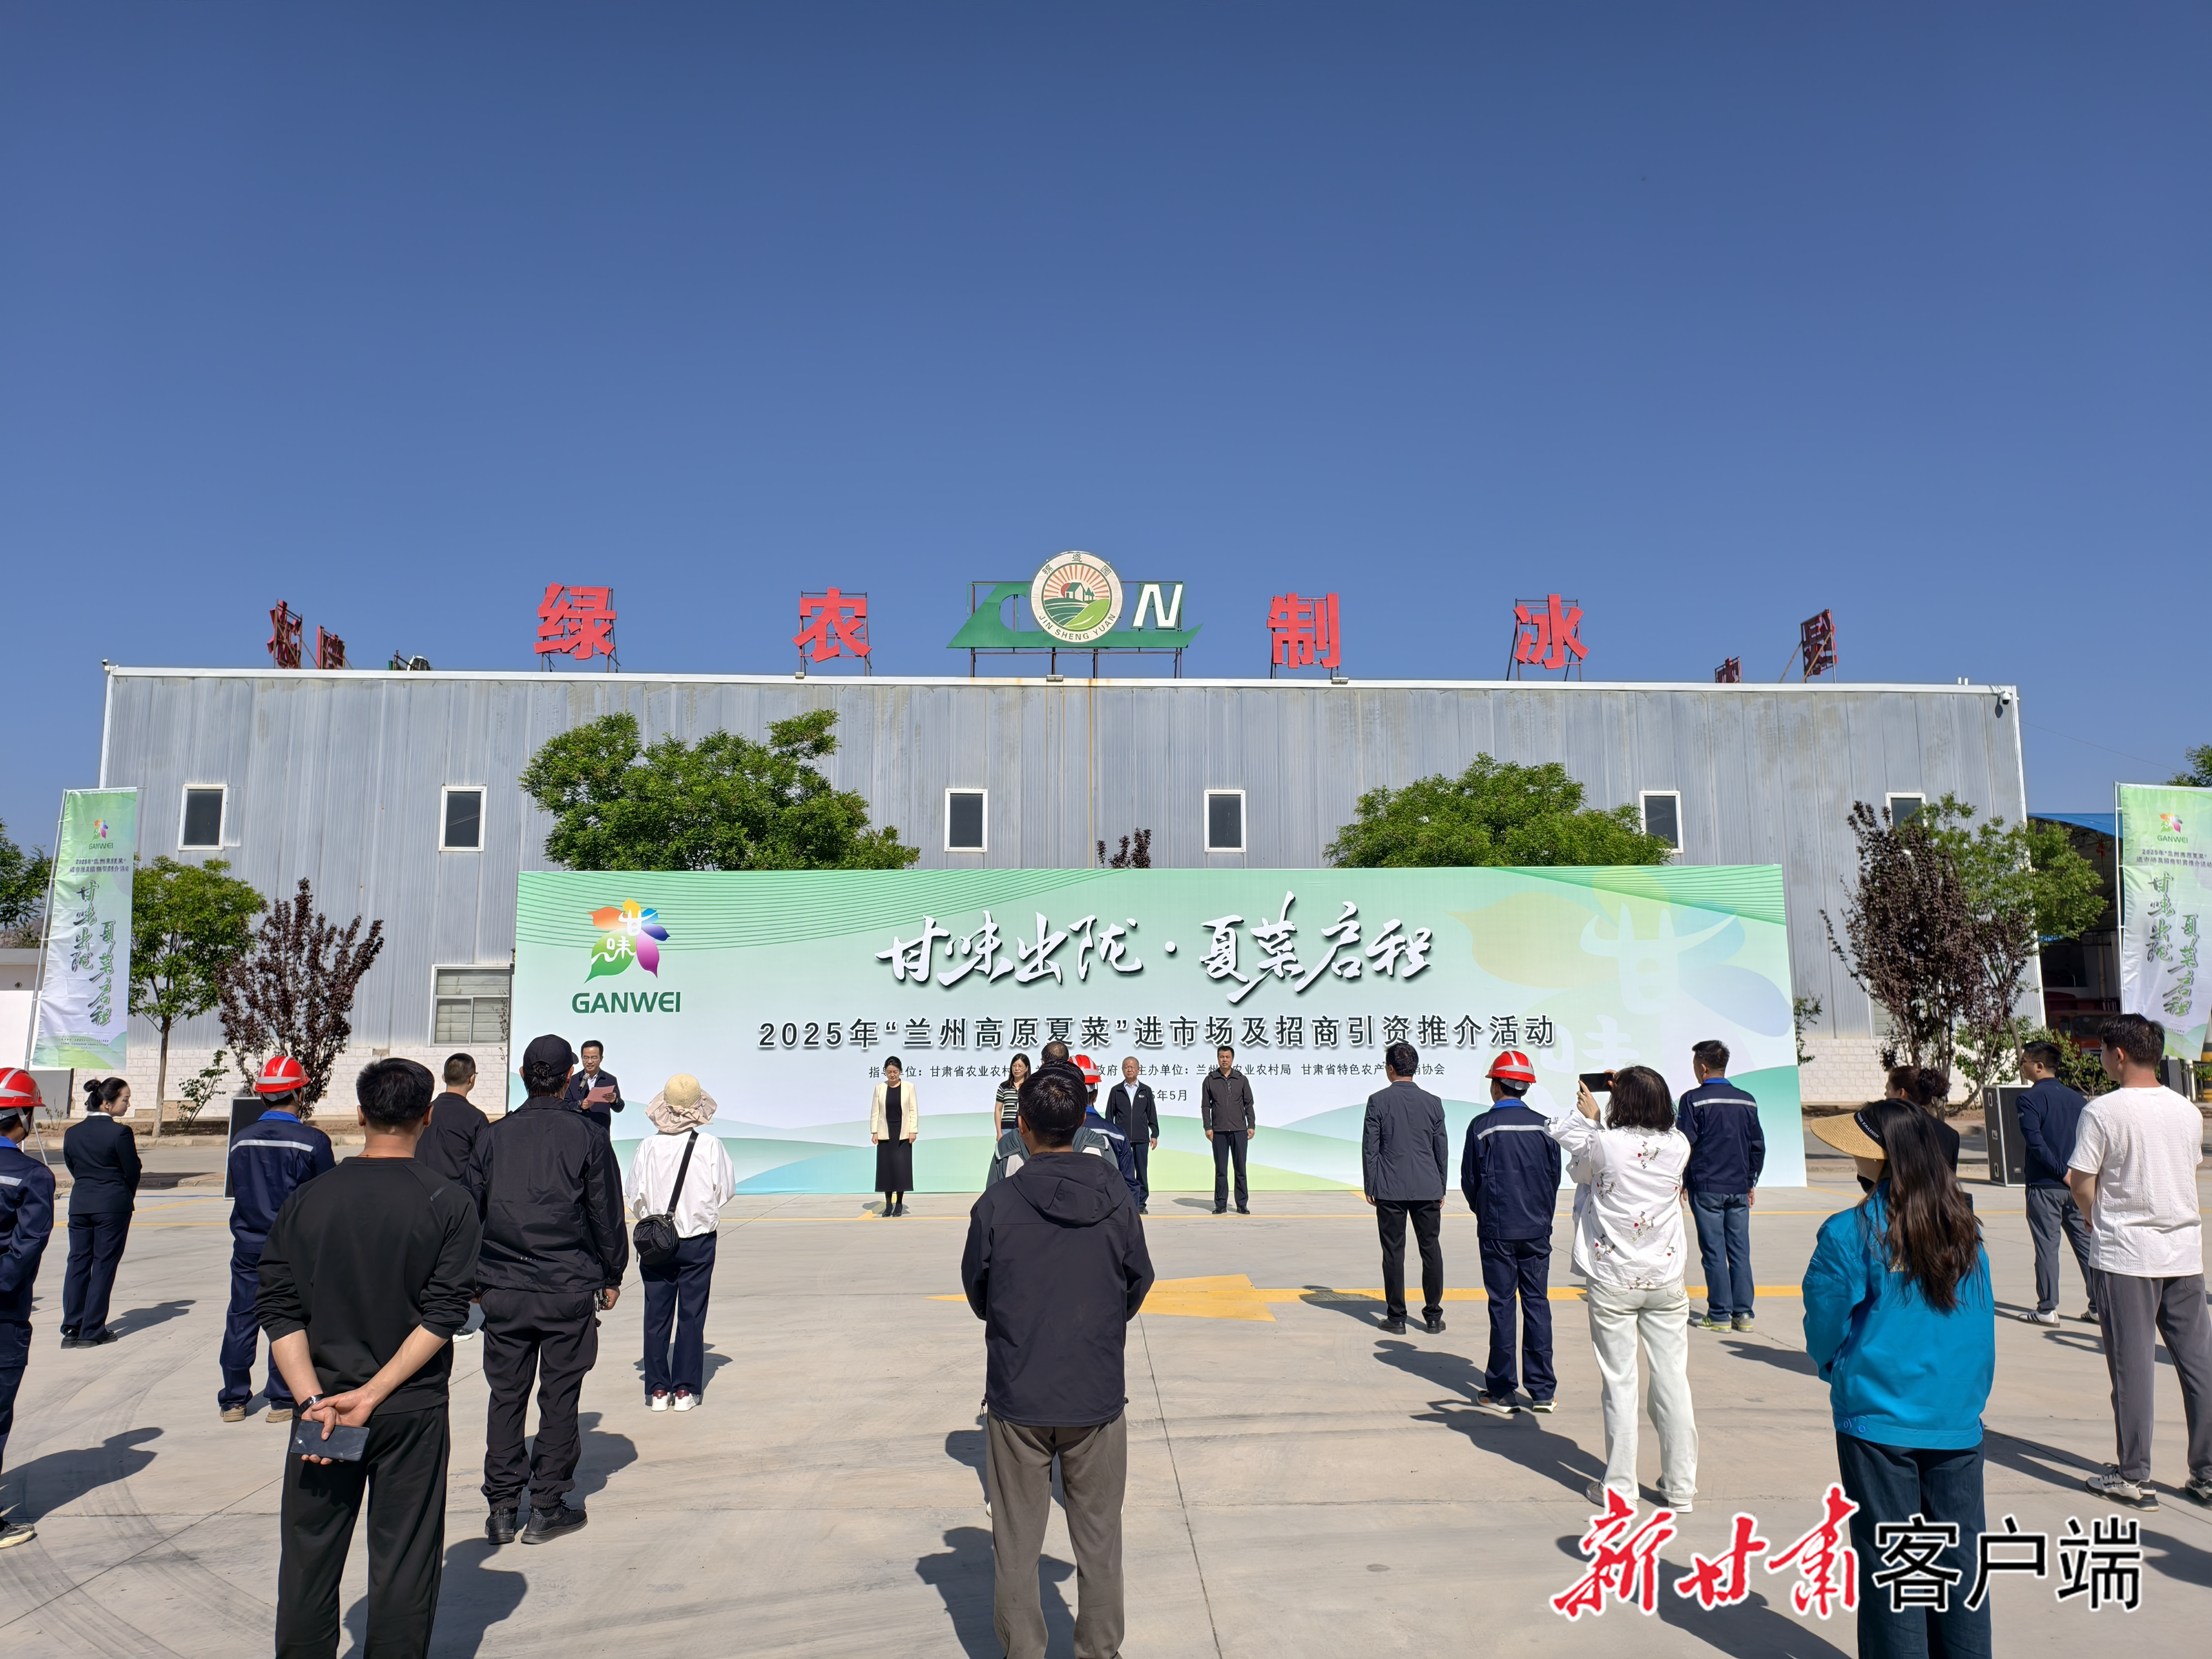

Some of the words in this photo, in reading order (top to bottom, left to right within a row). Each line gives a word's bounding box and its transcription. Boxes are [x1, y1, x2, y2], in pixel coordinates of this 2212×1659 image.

[1038, 615, 1053, 630] JIN
[1055, 629, 1090, 640] SHENG
[1092, 613, 1116, 636] YUAN
[2157, 835, 2188, 844] GANWEI
[572, 992, 681, 1014] GANWEI
